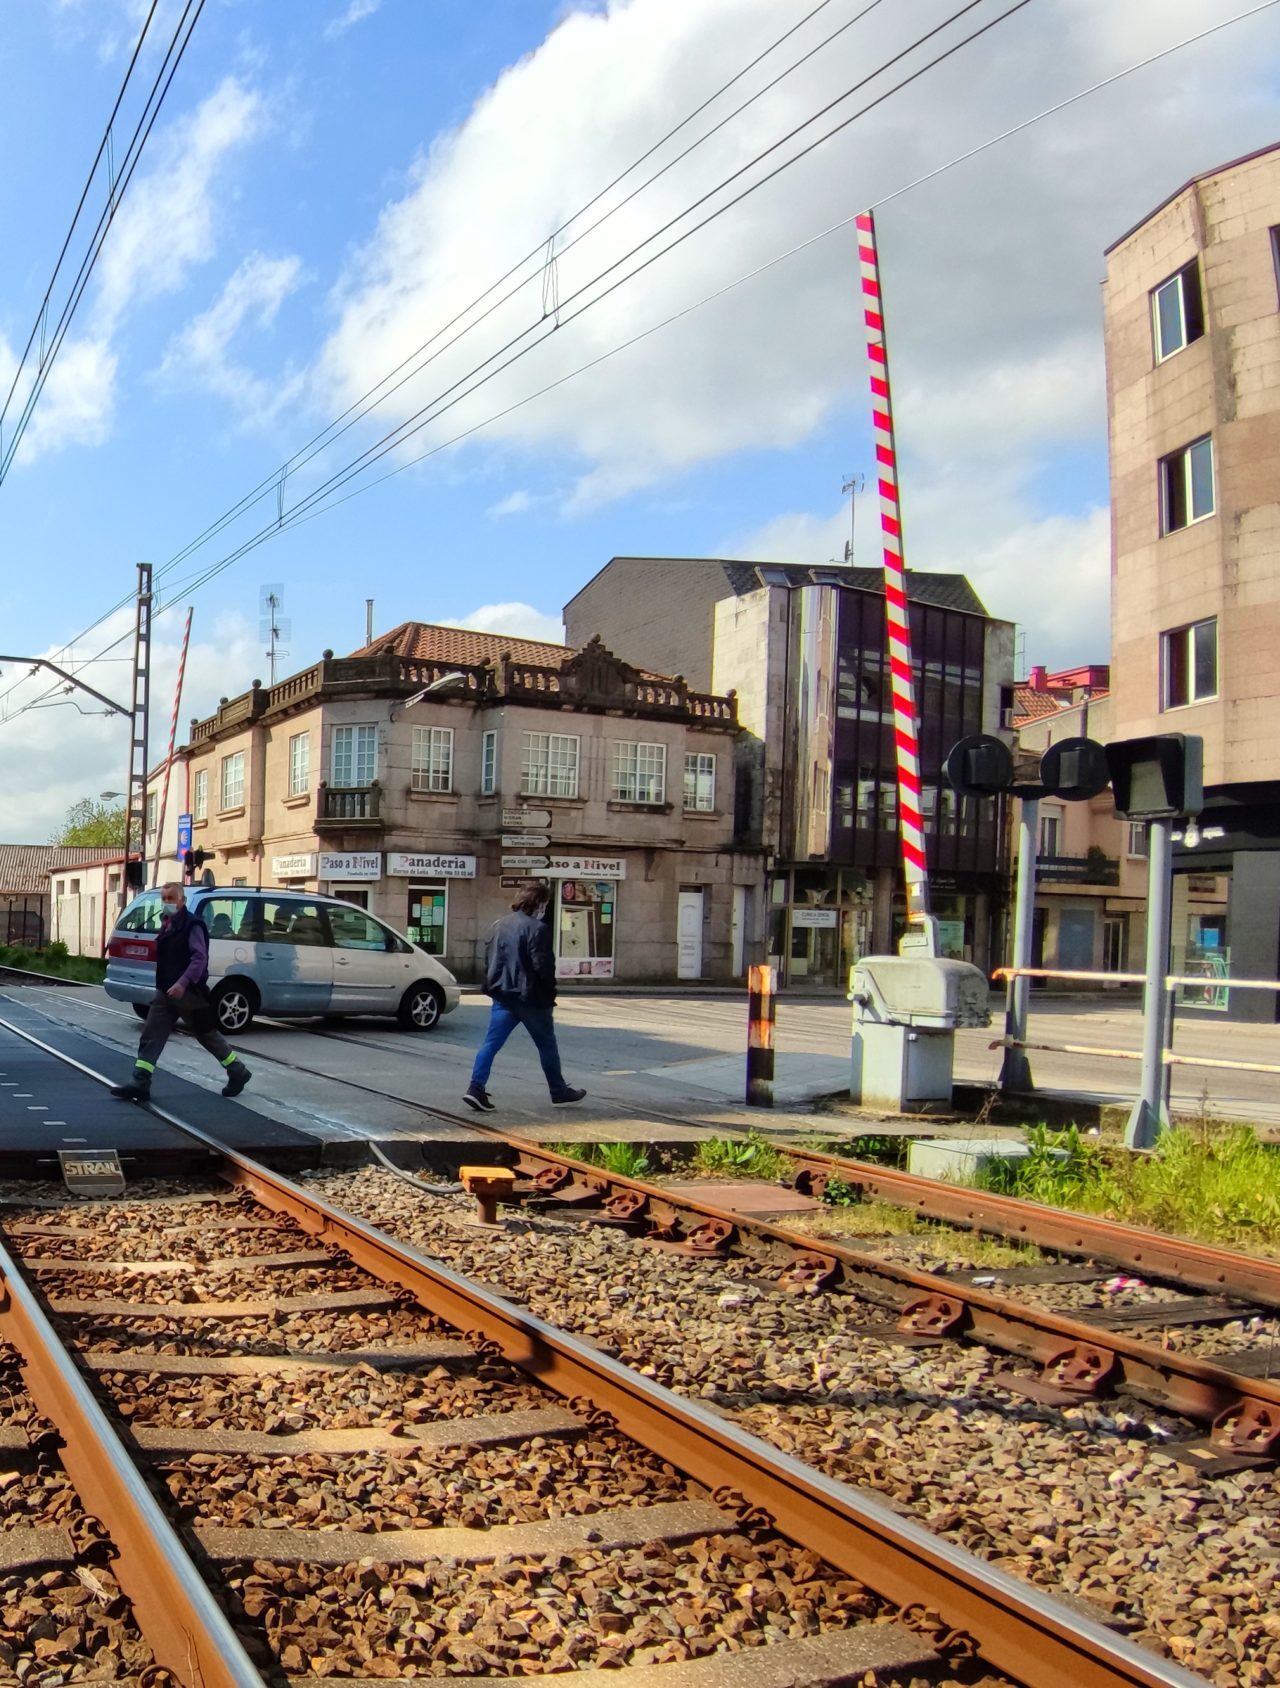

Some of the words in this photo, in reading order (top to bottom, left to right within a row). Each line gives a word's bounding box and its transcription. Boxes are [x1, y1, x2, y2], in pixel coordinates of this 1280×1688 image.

[322, 856, 343, 869] Paso
[345, 859, 350, 869] a
[352, 856, 378, 869] Nivel
[549, 860, 569, 868] aso
[584, 860, 620, 870] Nivel
